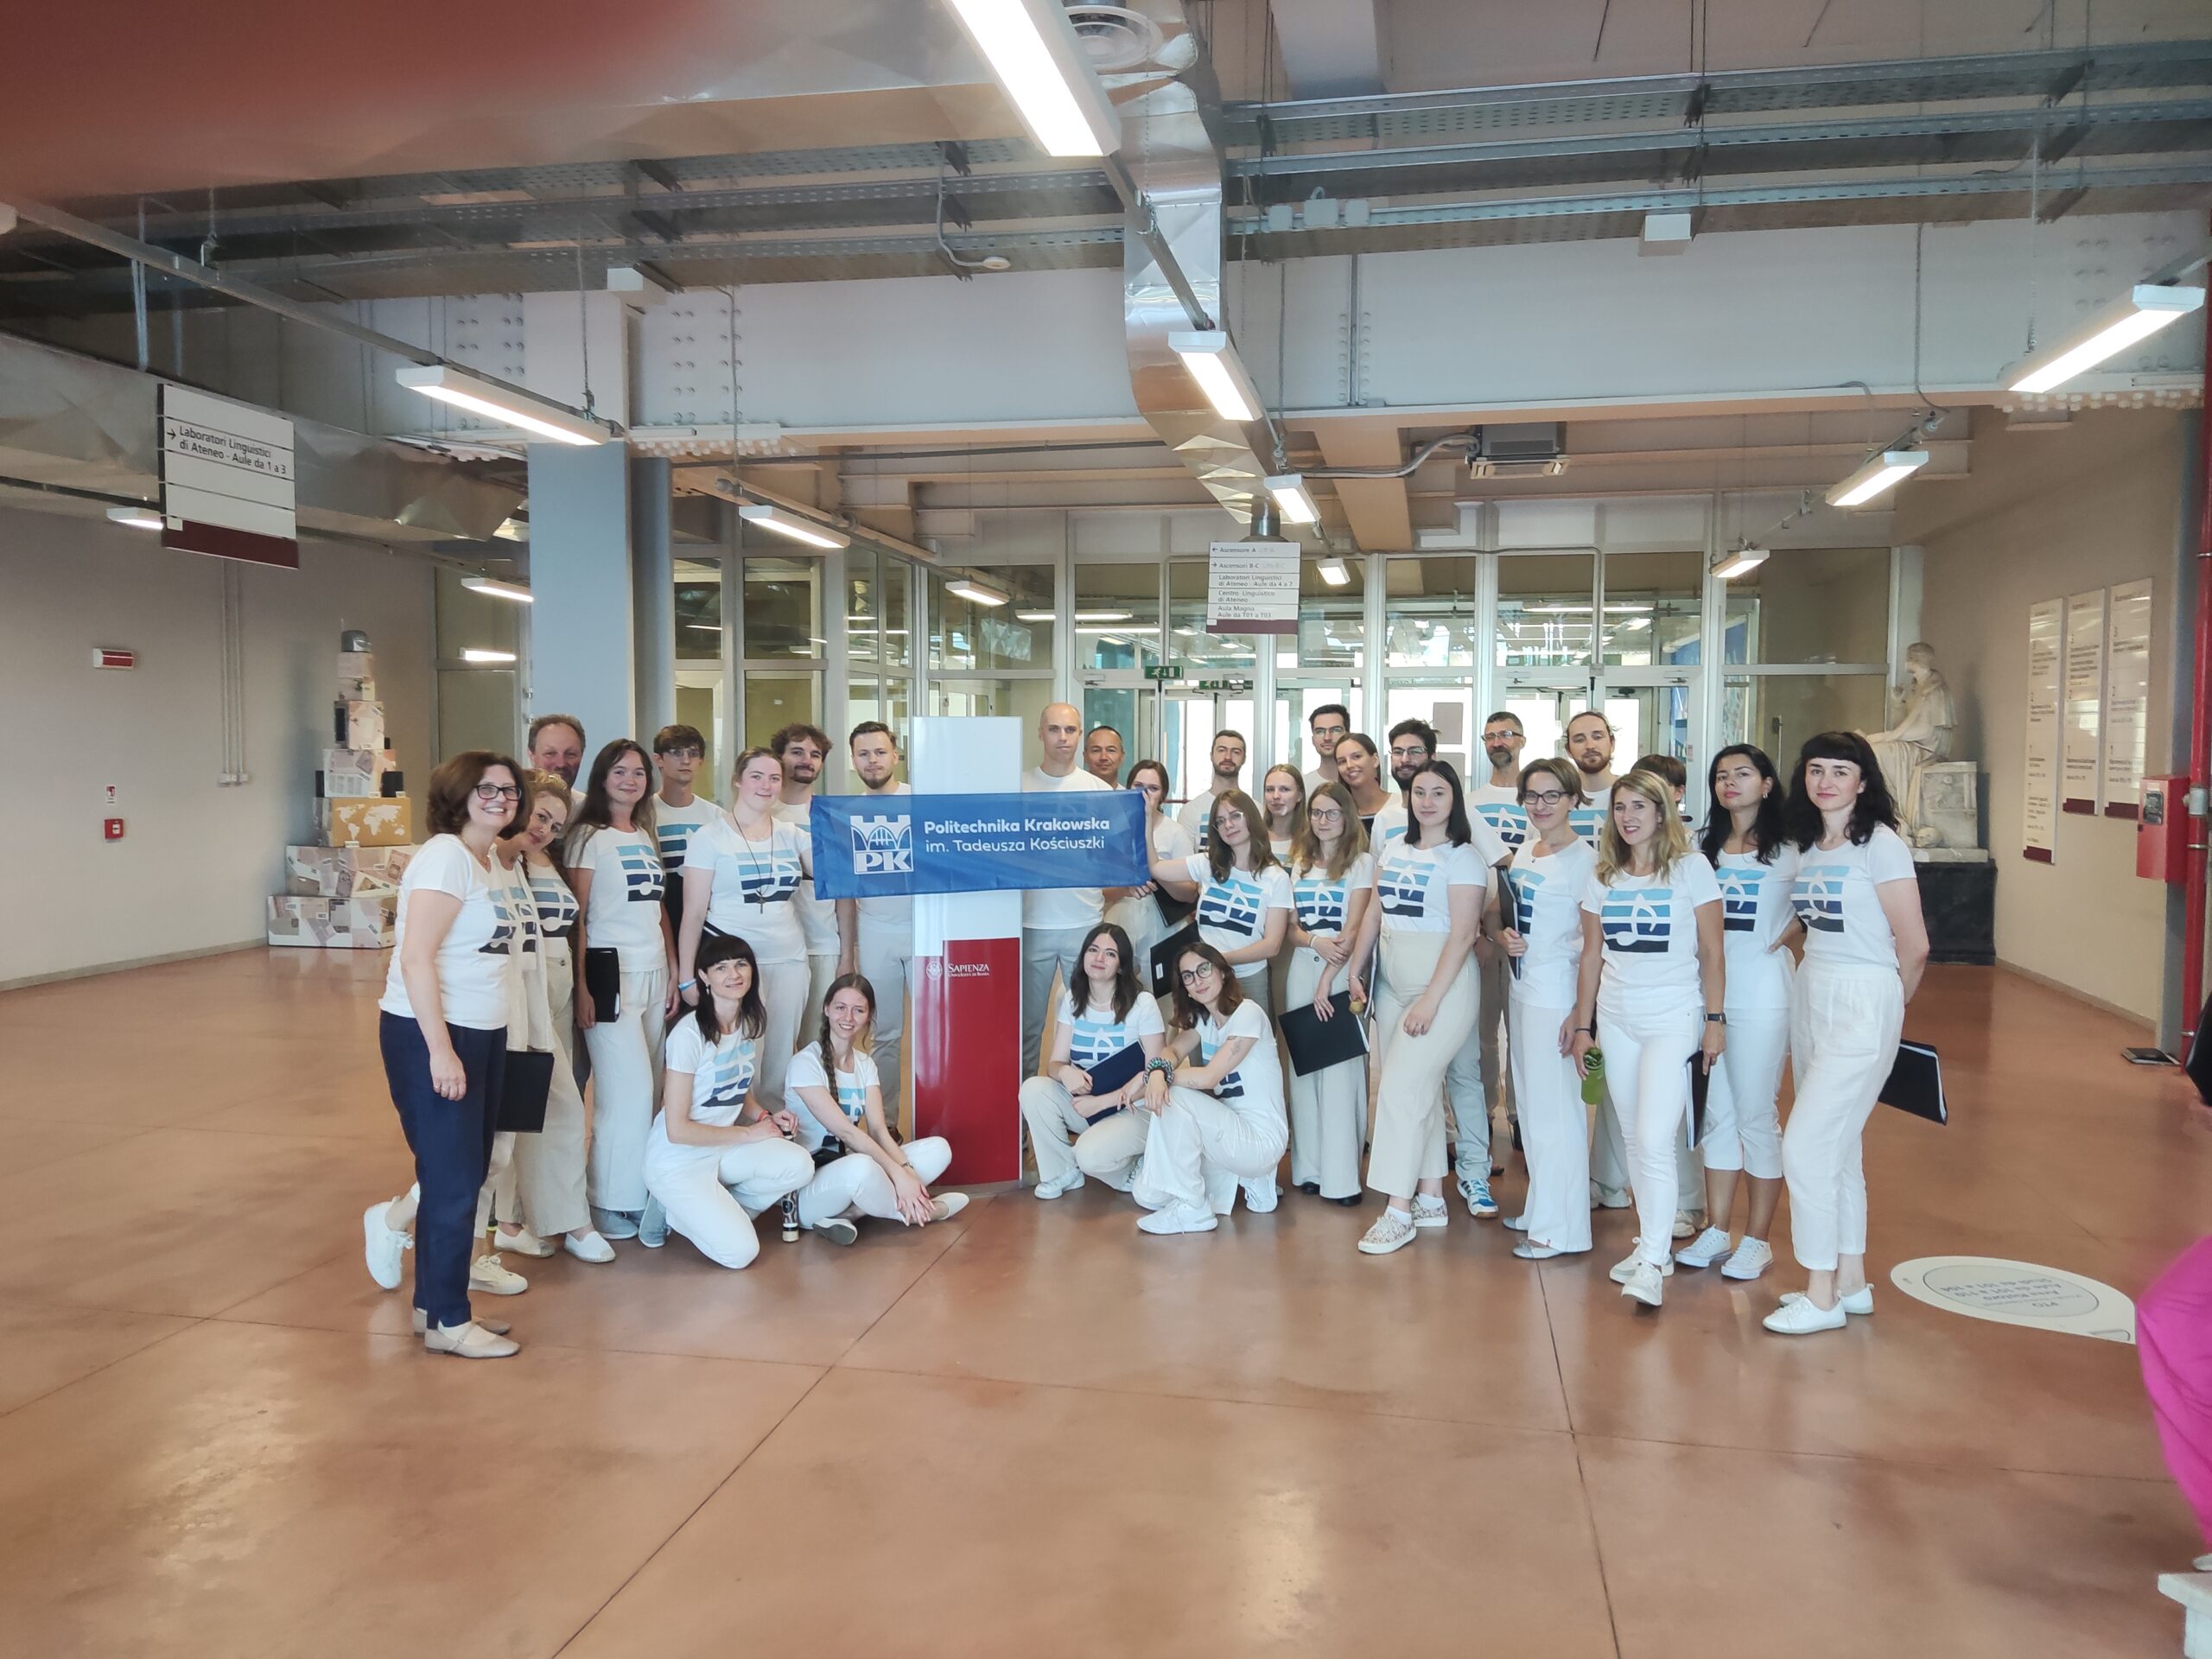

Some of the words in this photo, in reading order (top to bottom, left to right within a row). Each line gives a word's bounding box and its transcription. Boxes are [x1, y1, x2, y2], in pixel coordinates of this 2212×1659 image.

[180, 426, 226, 446] Laboratori
[229, 438, 271, 458] Linguistici
[180, 440, 188, 450] di
[191, 442, 224, 459] Ateneo
[232, 454, 251, 467] Aule
[255, 459, 264, 469] da
[281, 465, 286, 474] 3
[924, 819, 1020, 835] Politechnika
[1024, 817, 1110, 832] Krakowska
[925, 840, 950, 853] im.
[953, 839, 1026, 852] Tadeusza
[1030, 836, 1105, 851] Kościuszki
[862, 851, 912, 872] PK
[948, 963, 989, 973] SAPIENZA
